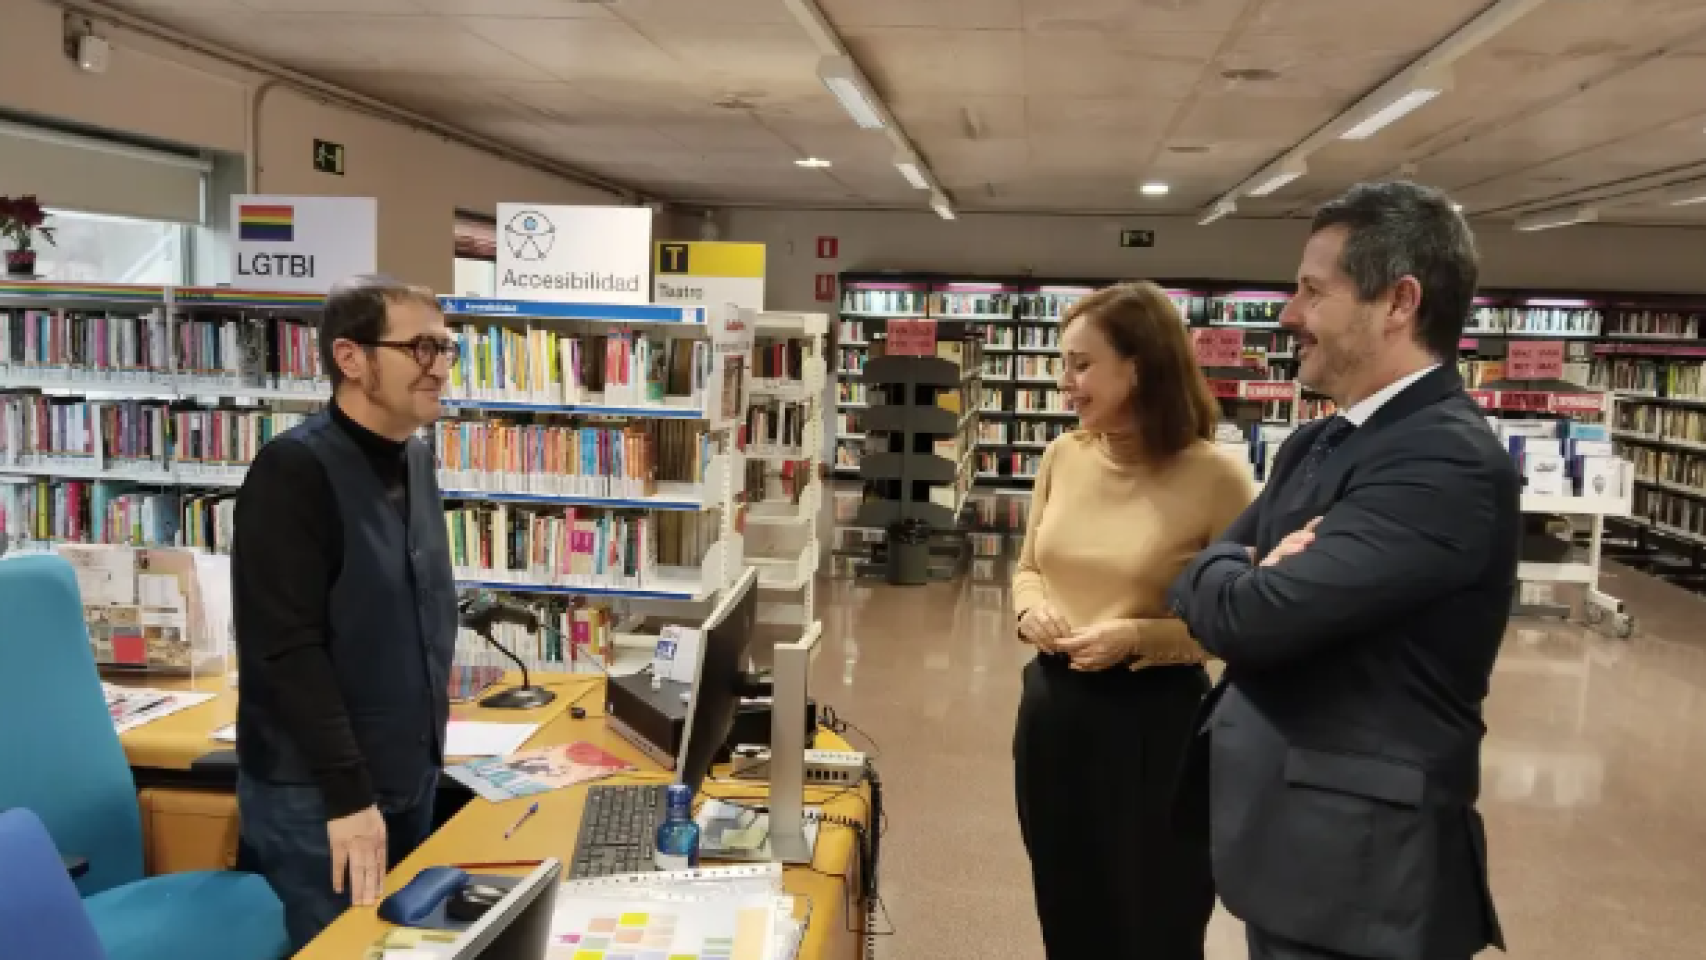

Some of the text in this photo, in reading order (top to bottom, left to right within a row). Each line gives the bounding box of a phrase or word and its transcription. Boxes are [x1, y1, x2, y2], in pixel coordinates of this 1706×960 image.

[237, 252, 315, 278] LGTBI
[664, 246, 683, 270] T
[501, 268, 639, 292] Accesibilidad
